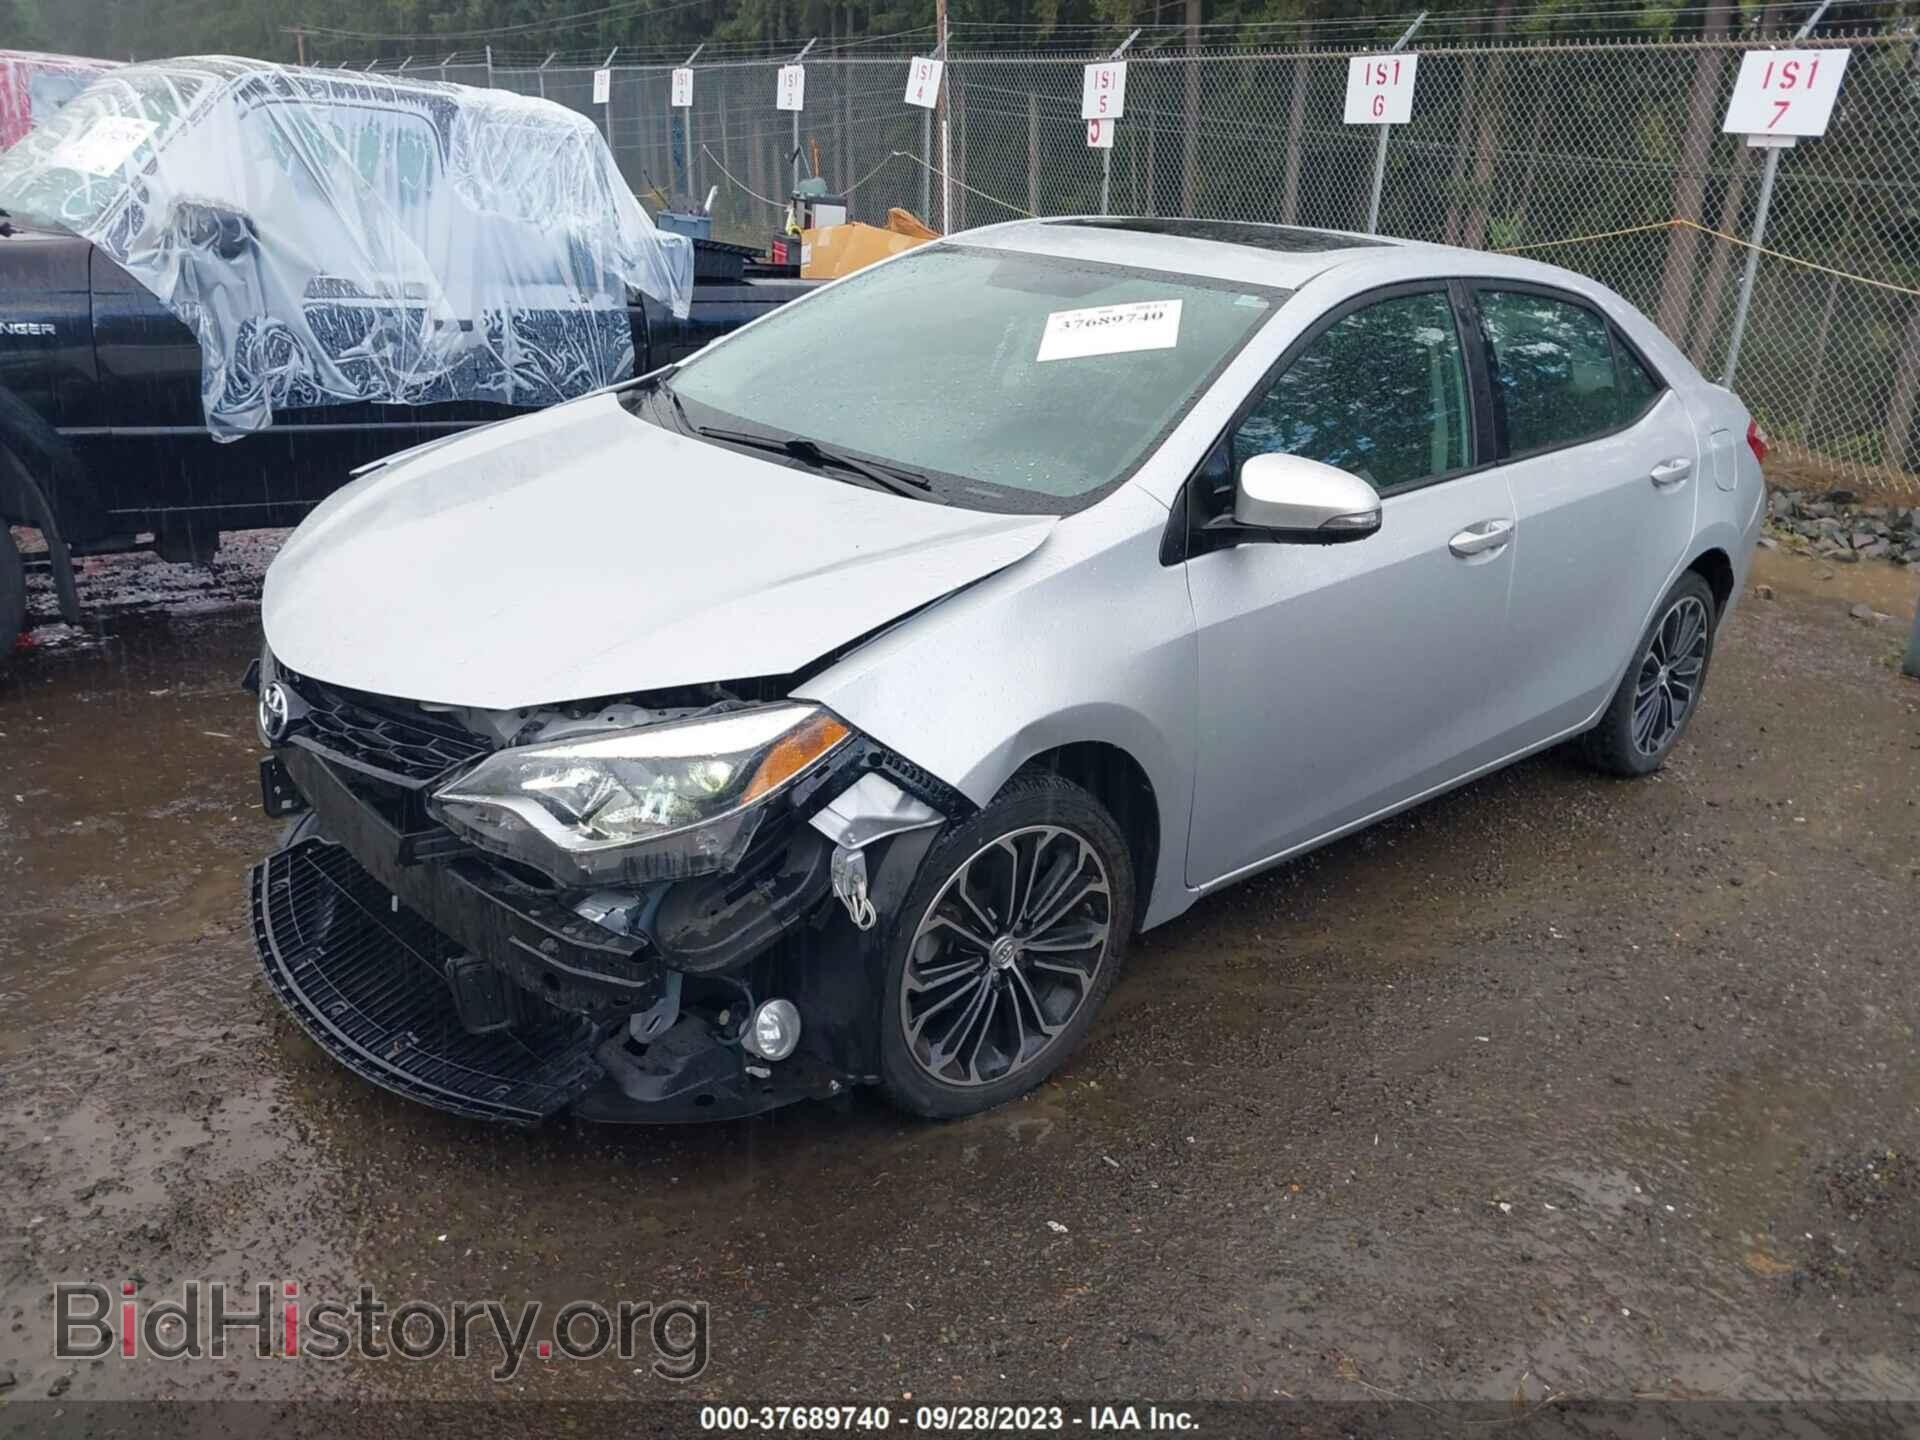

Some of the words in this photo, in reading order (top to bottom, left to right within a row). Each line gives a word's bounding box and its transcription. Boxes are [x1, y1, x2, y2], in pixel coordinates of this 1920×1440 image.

[1099, 95, 1108, 113] 5
[1373, 94, 1385, 117] 6
[1767, 101, 1791, 129] 7
